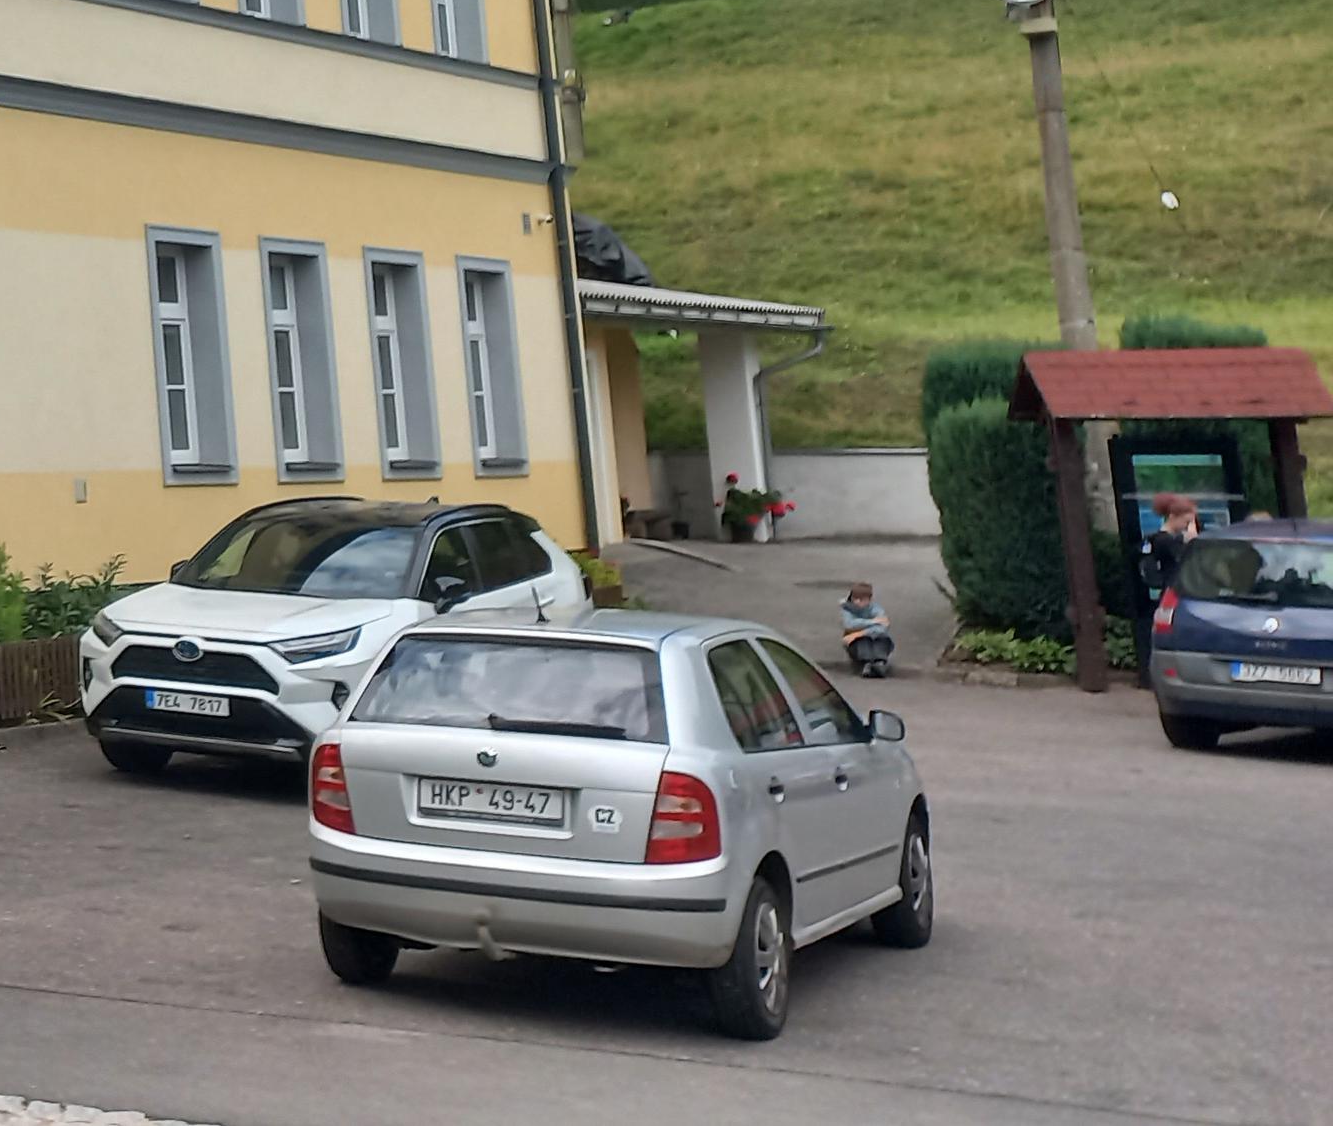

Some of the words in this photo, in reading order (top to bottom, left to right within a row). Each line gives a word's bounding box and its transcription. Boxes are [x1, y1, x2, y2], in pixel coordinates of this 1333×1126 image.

[431, 783, 471, 807] HKP
[488, 788, 551, 815] 49-47
[595, 807, 616, 825] CZ
